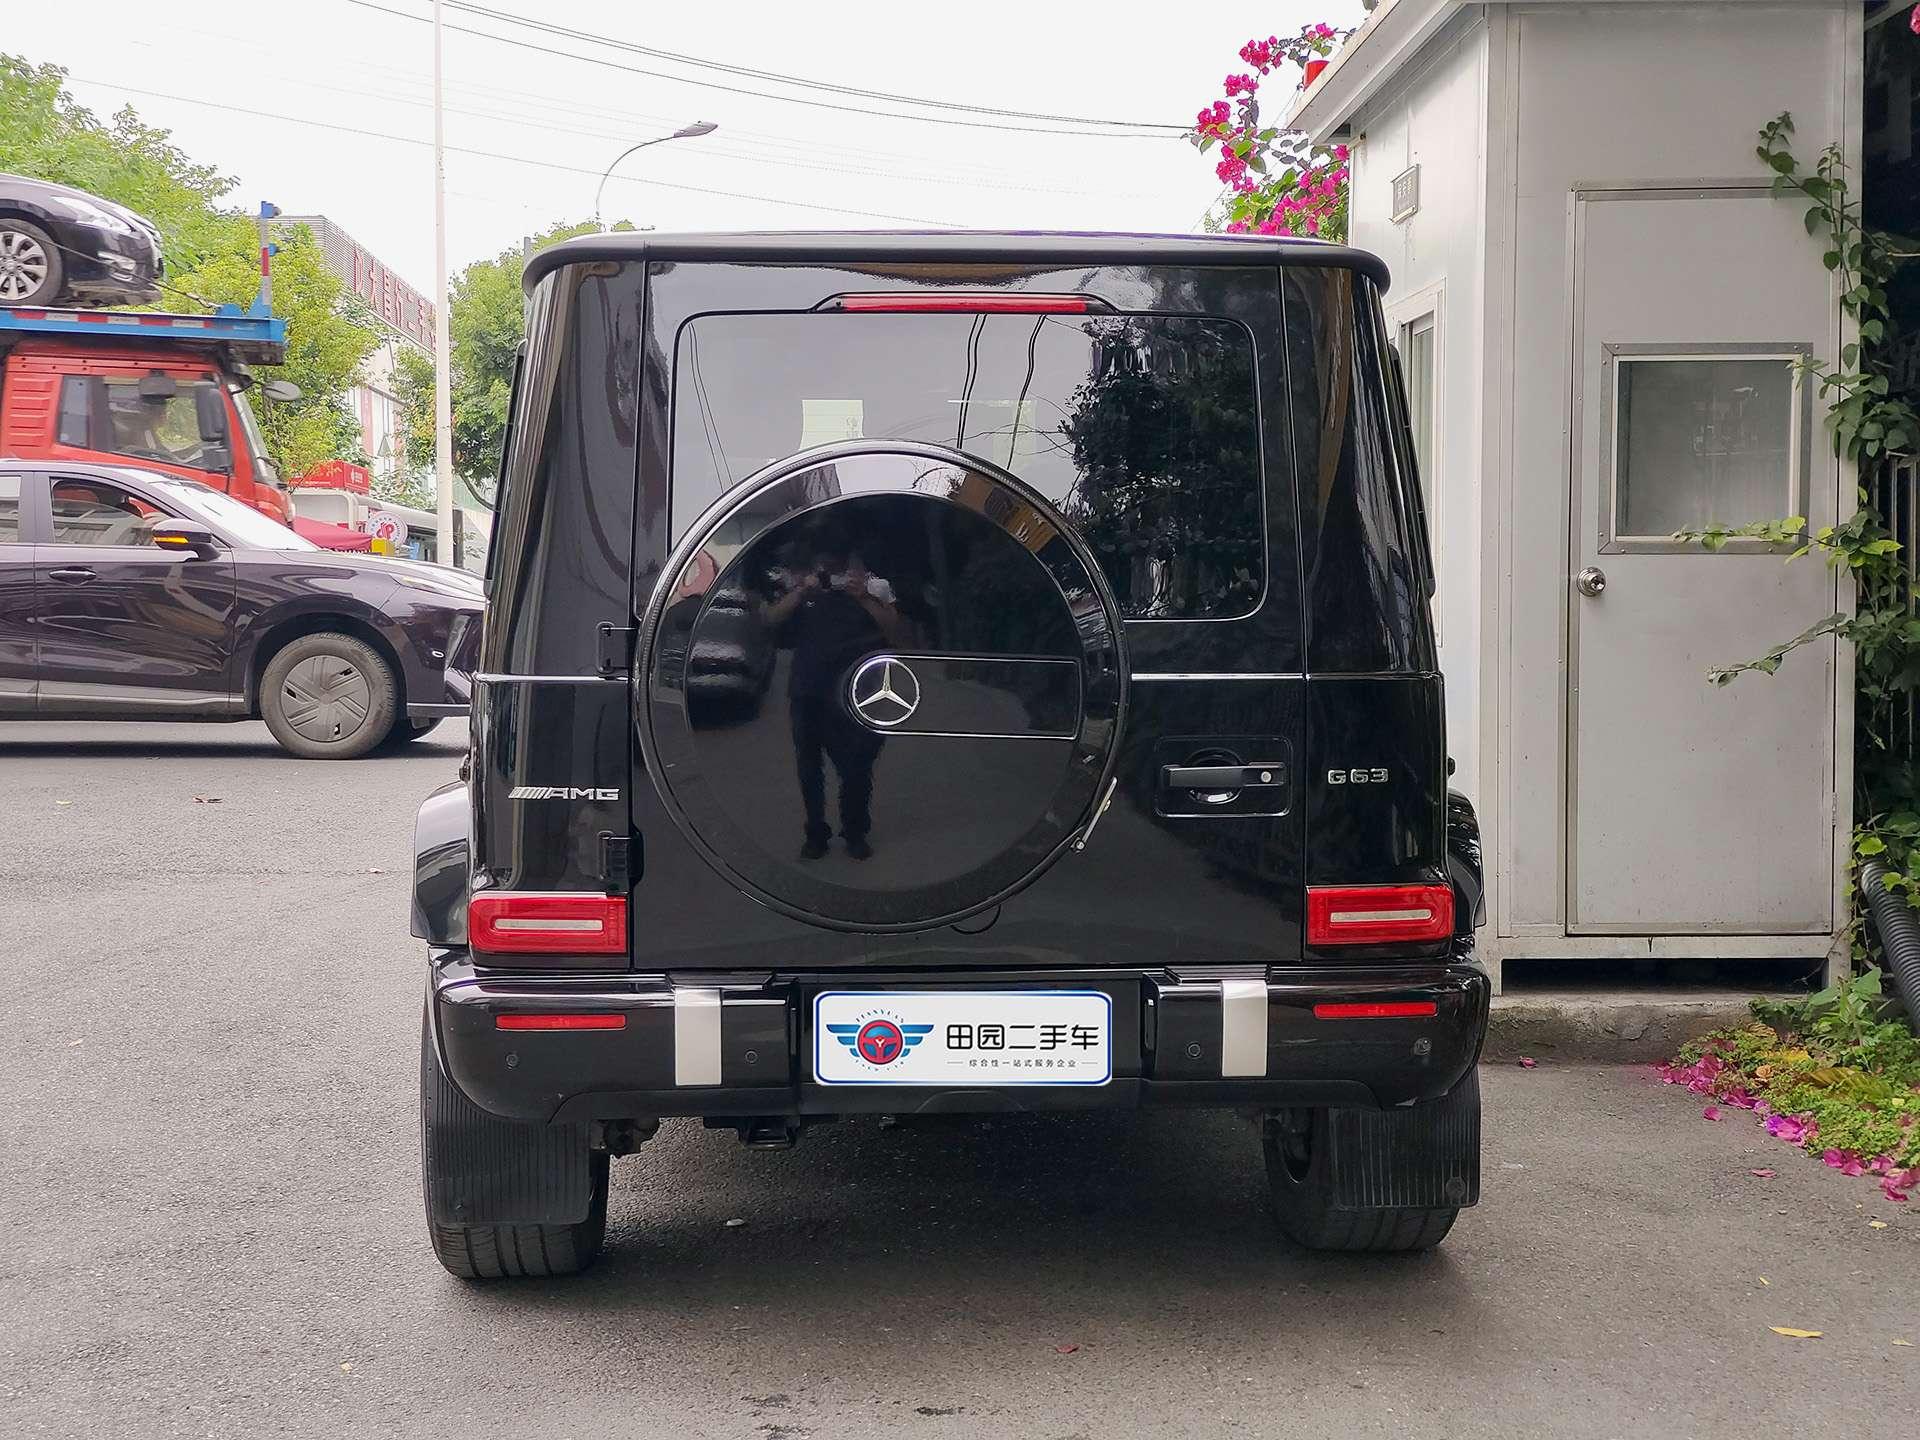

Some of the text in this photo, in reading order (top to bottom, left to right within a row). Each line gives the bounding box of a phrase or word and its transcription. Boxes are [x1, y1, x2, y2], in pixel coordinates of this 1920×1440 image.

[946, 1023, 1100, 1051] 田园二手车
